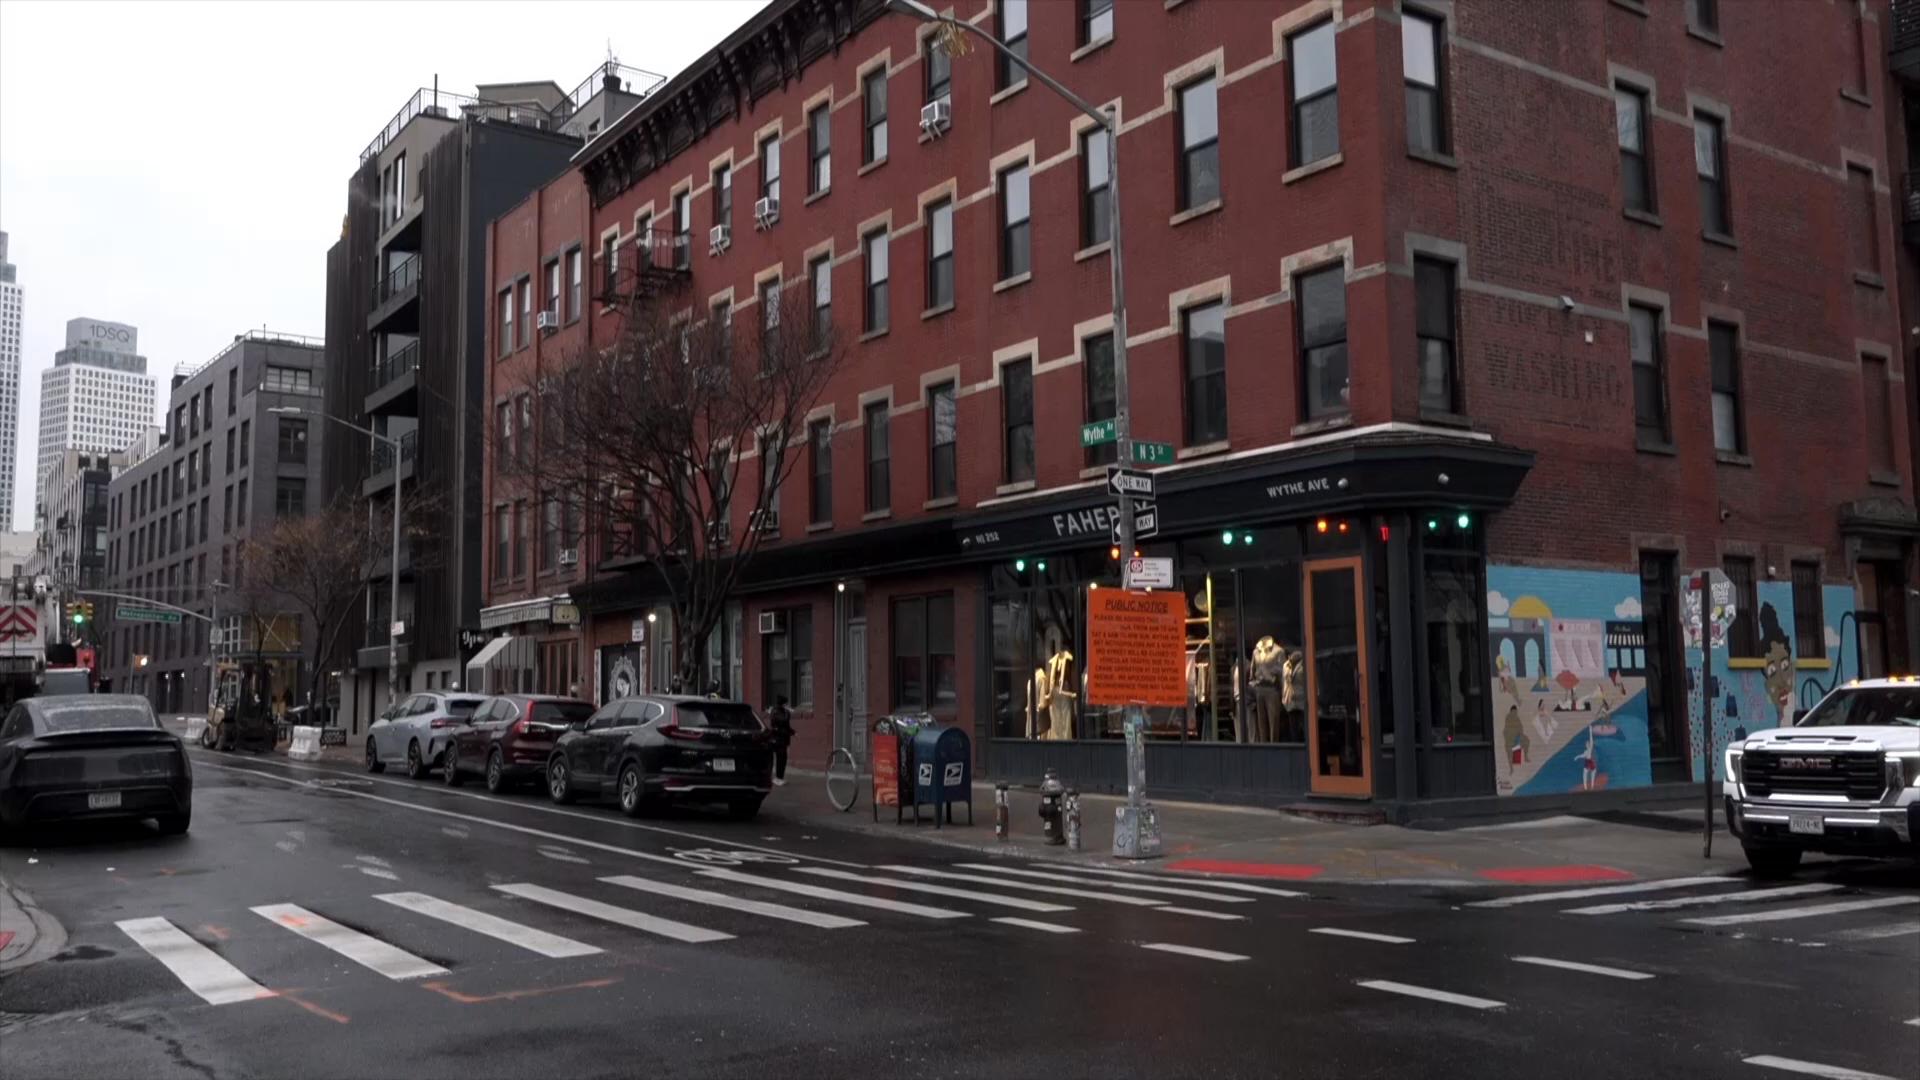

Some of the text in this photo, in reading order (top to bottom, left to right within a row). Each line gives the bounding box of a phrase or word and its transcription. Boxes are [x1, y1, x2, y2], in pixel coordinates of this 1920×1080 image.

[90, 324, 130, 343] 1DSQ
[1083, 426, 1105, 445] Wythe
[1140, 443, 1146, 460] N
[1149, 445, 1155, 461] 3
[1117, 474, 1149, 490] ONE WAY
[1266, 477, 1330, 498] WYTHE AVE
[1139, 515, 1152, 530] WAY
[1105, 599, 1169, 614] PUBLIC NOTICE
[1780, 757, 1832, 769] GMC
